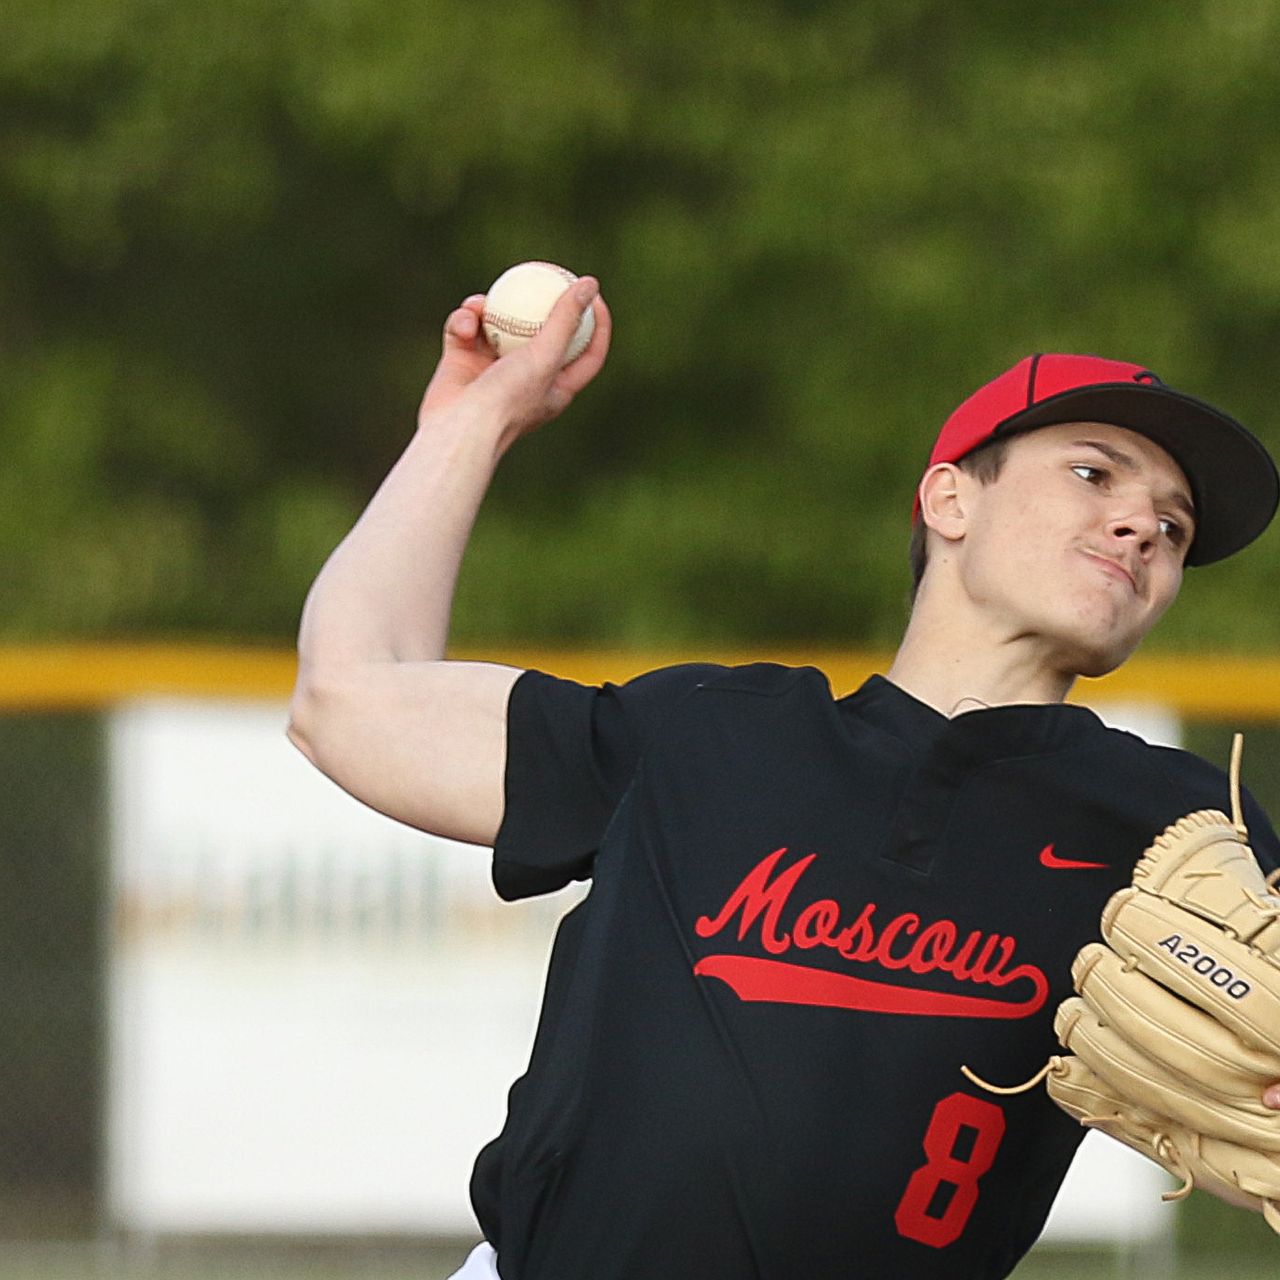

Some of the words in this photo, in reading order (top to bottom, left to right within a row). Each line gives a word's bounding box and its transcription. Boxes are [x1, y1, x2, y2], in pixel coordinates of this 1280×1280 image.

[694, 847, 1028, 986] Moscow
[1158, 934, 1251, 1000] A2000
[894, 1092, 1006, 1249] 8
